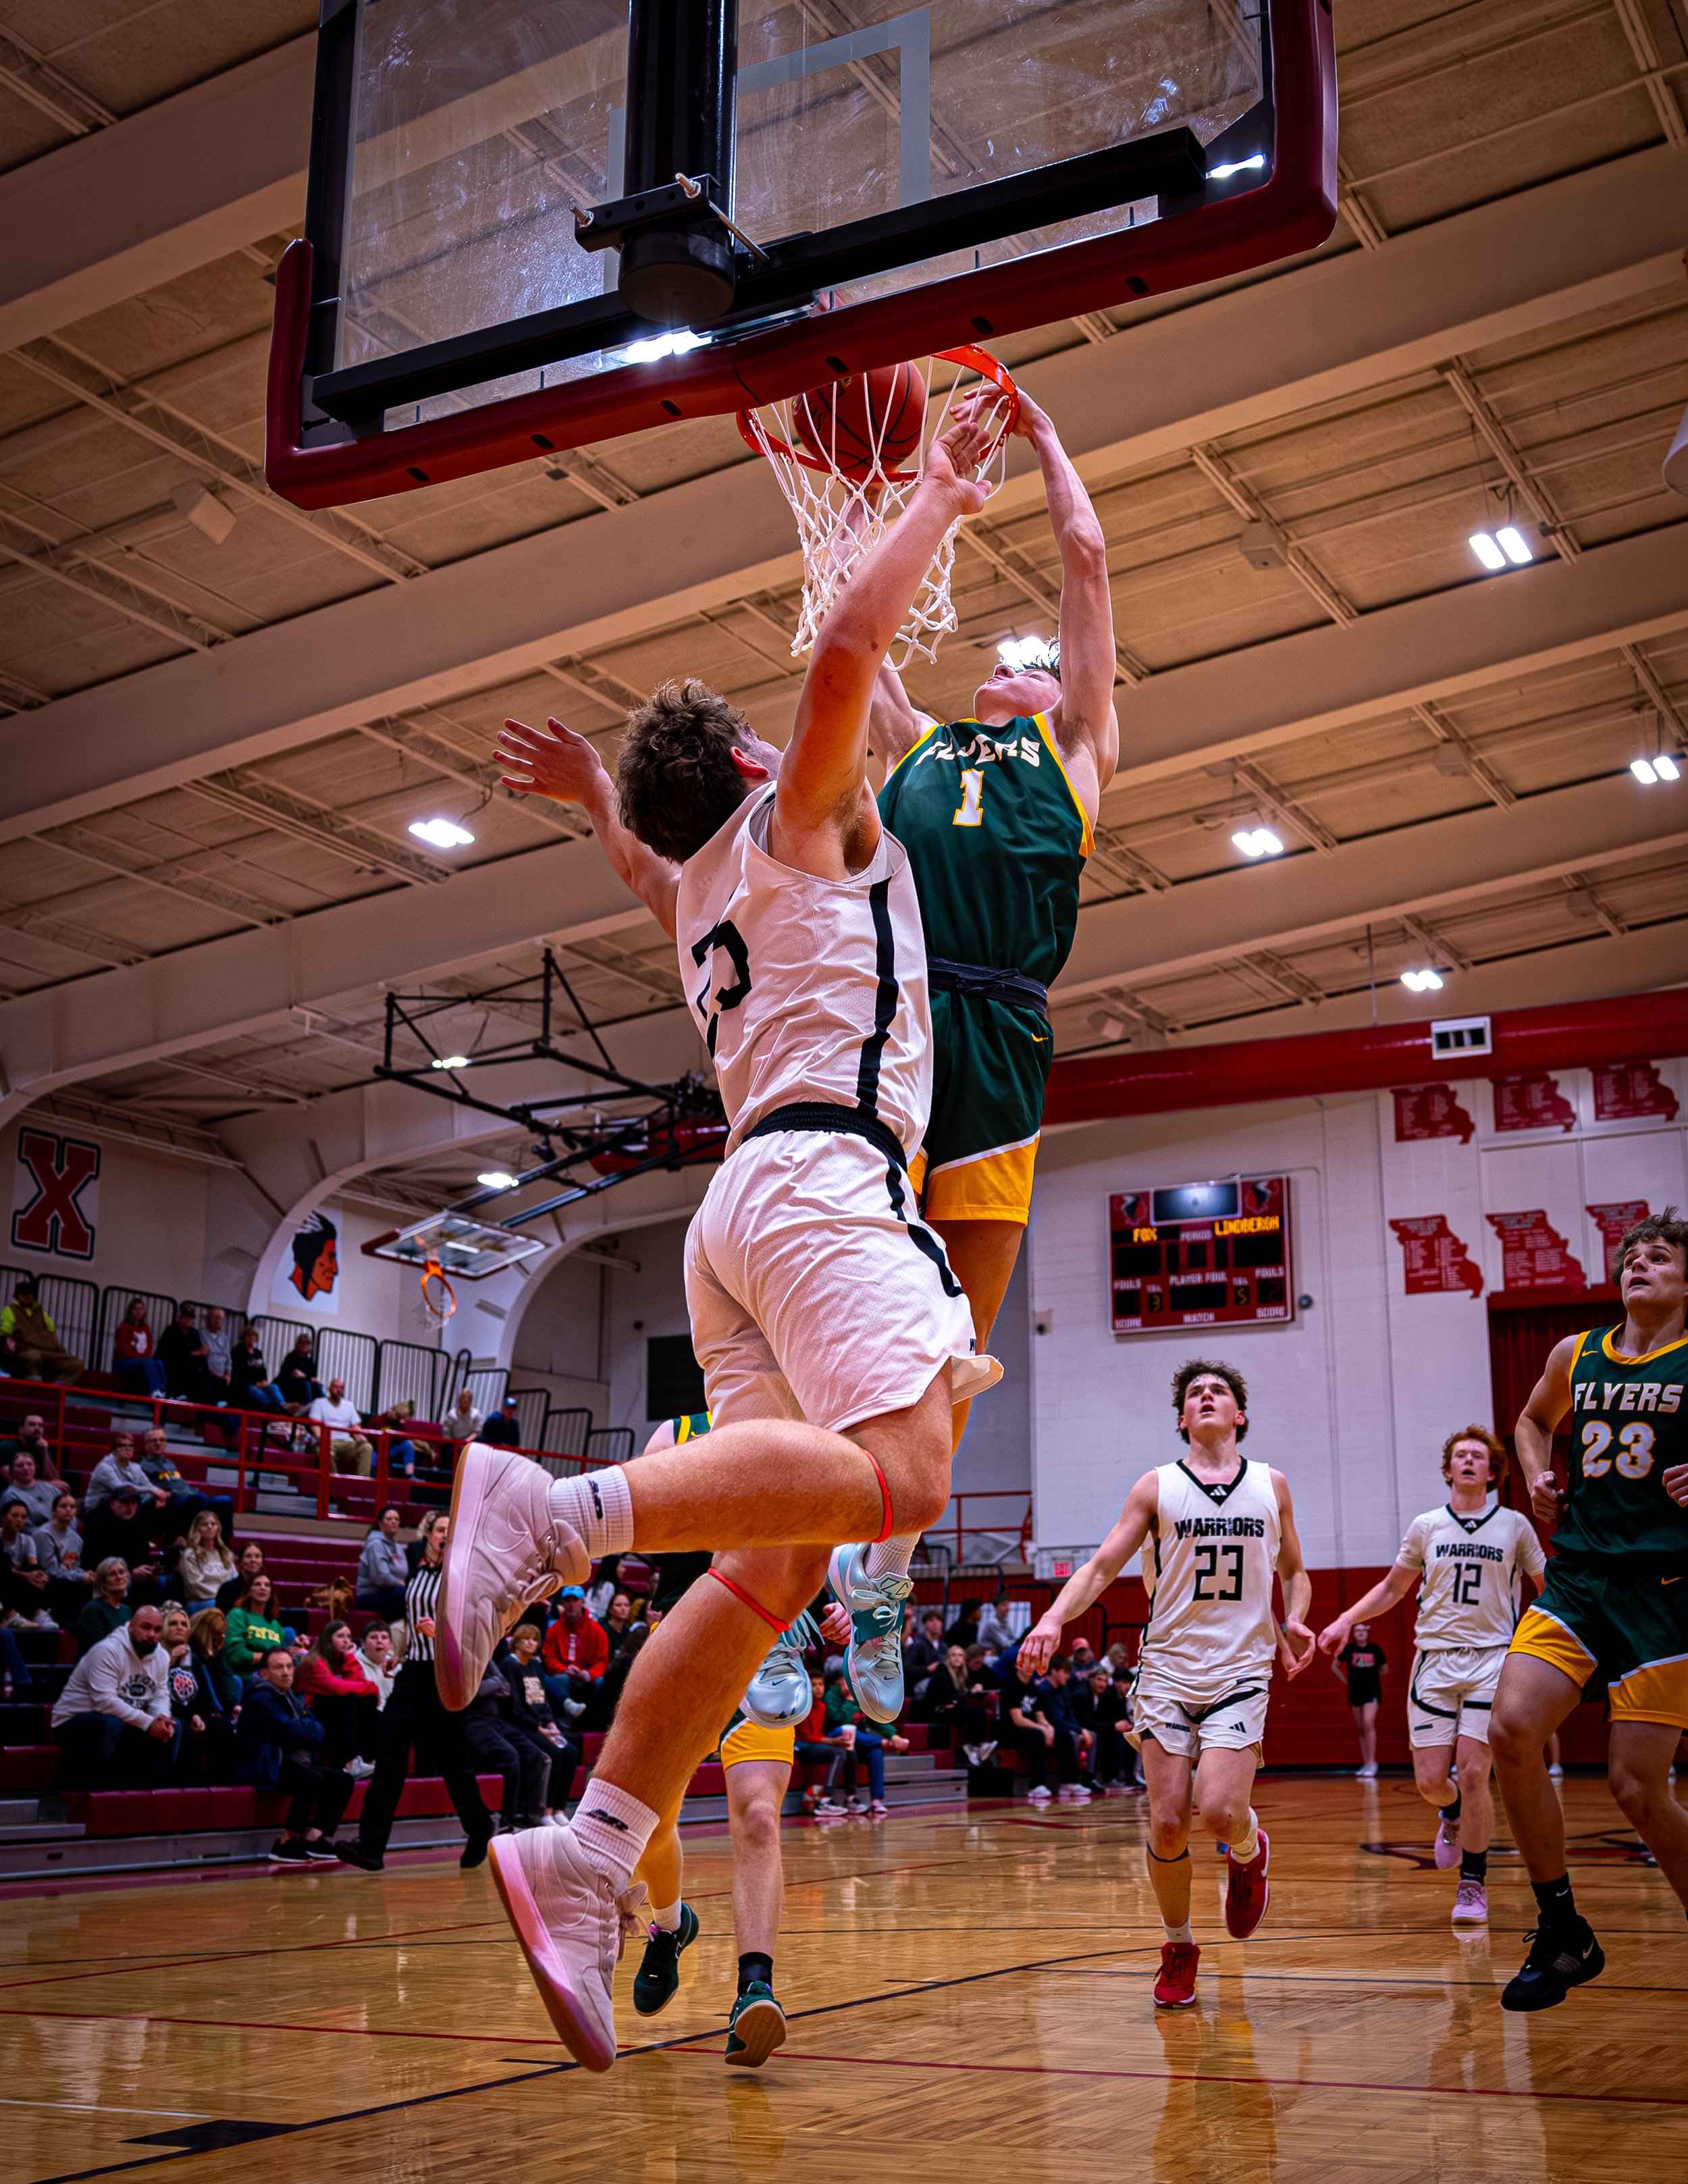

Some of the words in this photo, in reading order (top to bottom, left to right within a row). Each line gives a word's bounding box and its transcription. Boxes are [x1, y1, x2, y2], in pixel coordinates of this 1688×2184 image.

[952, 768, 984, 826] 1
[11, 1127, 101, 1260] X
[1133, 1227, 1157, 1242] FOX
[1574, 1382, 1684, 1413] FLYERS
[1581, 1420, 1656, 1479] 23
[1174, 1517, 1265, 1540] WARRIORS
[1192, 1545, 1244, 1601] 23
[1436, 1543, 1504, 1562] WARRIORS
[1452, 1562, 1482, 1605] 12
